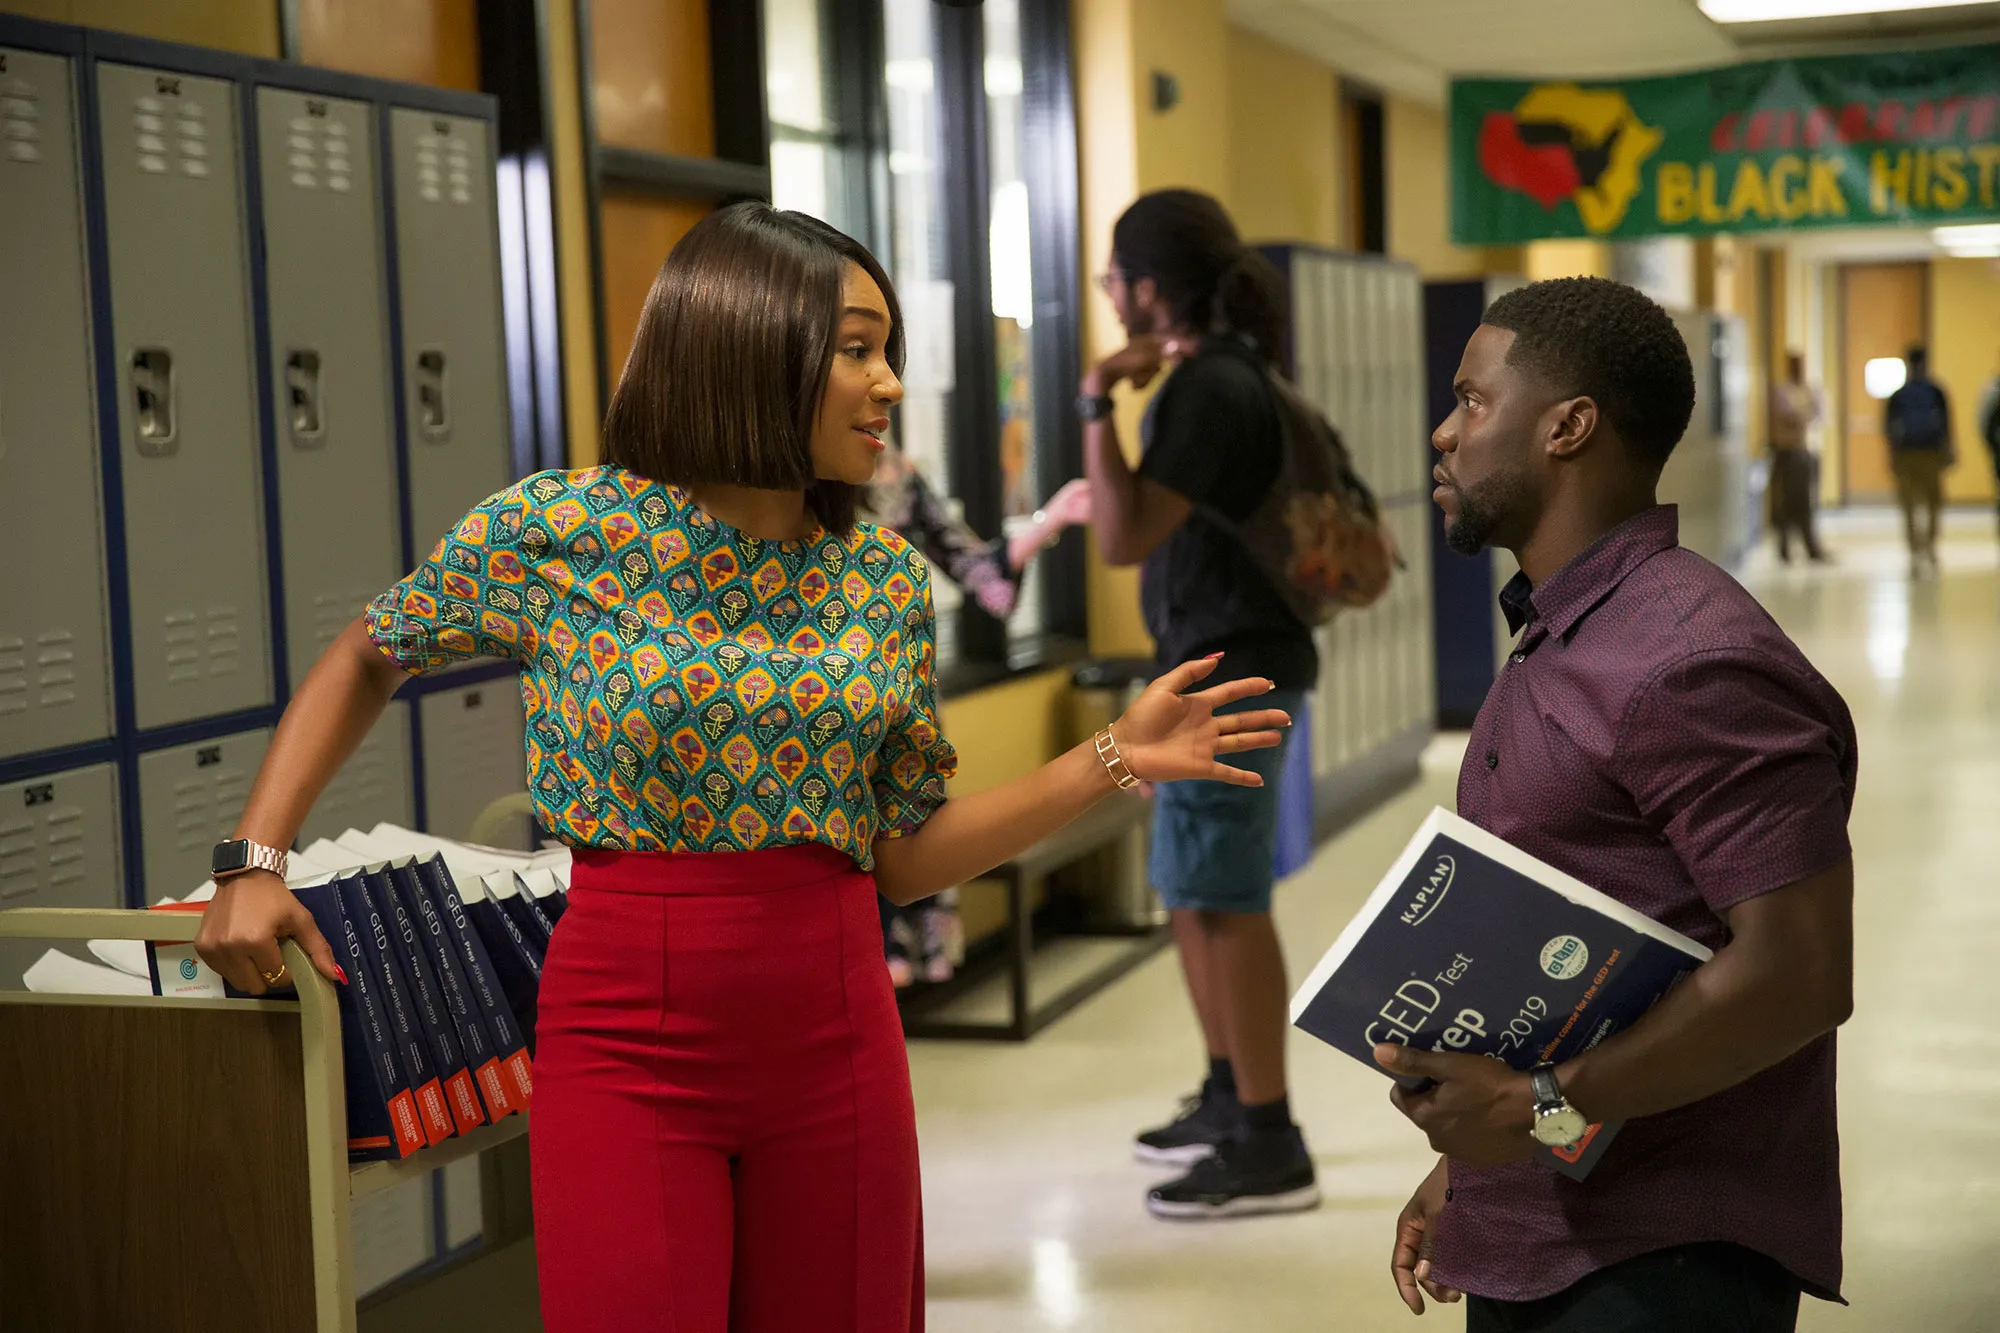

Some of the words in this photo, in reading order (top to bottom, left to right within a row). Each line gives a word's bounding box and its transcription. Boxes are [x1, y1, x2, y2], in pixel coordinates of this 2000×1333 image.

[1656, 154, 1847, 224] BLACK
[1868, 142, 2000, 214] HIST
[447, 894, 466, 929] GED
[464, 941, 475, 962] Prep
[1400, 863, 1450, 923] KAPLAN
[344, 920, 360, 957] GED
[357, 971, 367, 993] Prep
[370, 913, 387, 950] GED
[384, 963, 393, 985] Prep
[396, 906, 413, 943] GED
[411, 956, 421, 978] Prep
[423, 900, 440, 935] GED
[439, 948, 449, 969] Prep
[1550, 941, 1577, 973] GED
[1365, 980, 1441, 1048] GED
[1434, 953, 1474, 986] Test
[1431, 1008, 1488, 1053] rep
[1541, 1037, 1561, 1060] online
[1559, 1011, 1580, 1038] course
[1575, 999, 1588, 1011] for
[1584, 985, 1598, 1000] the
[1605, 949, 1620, 967] test
